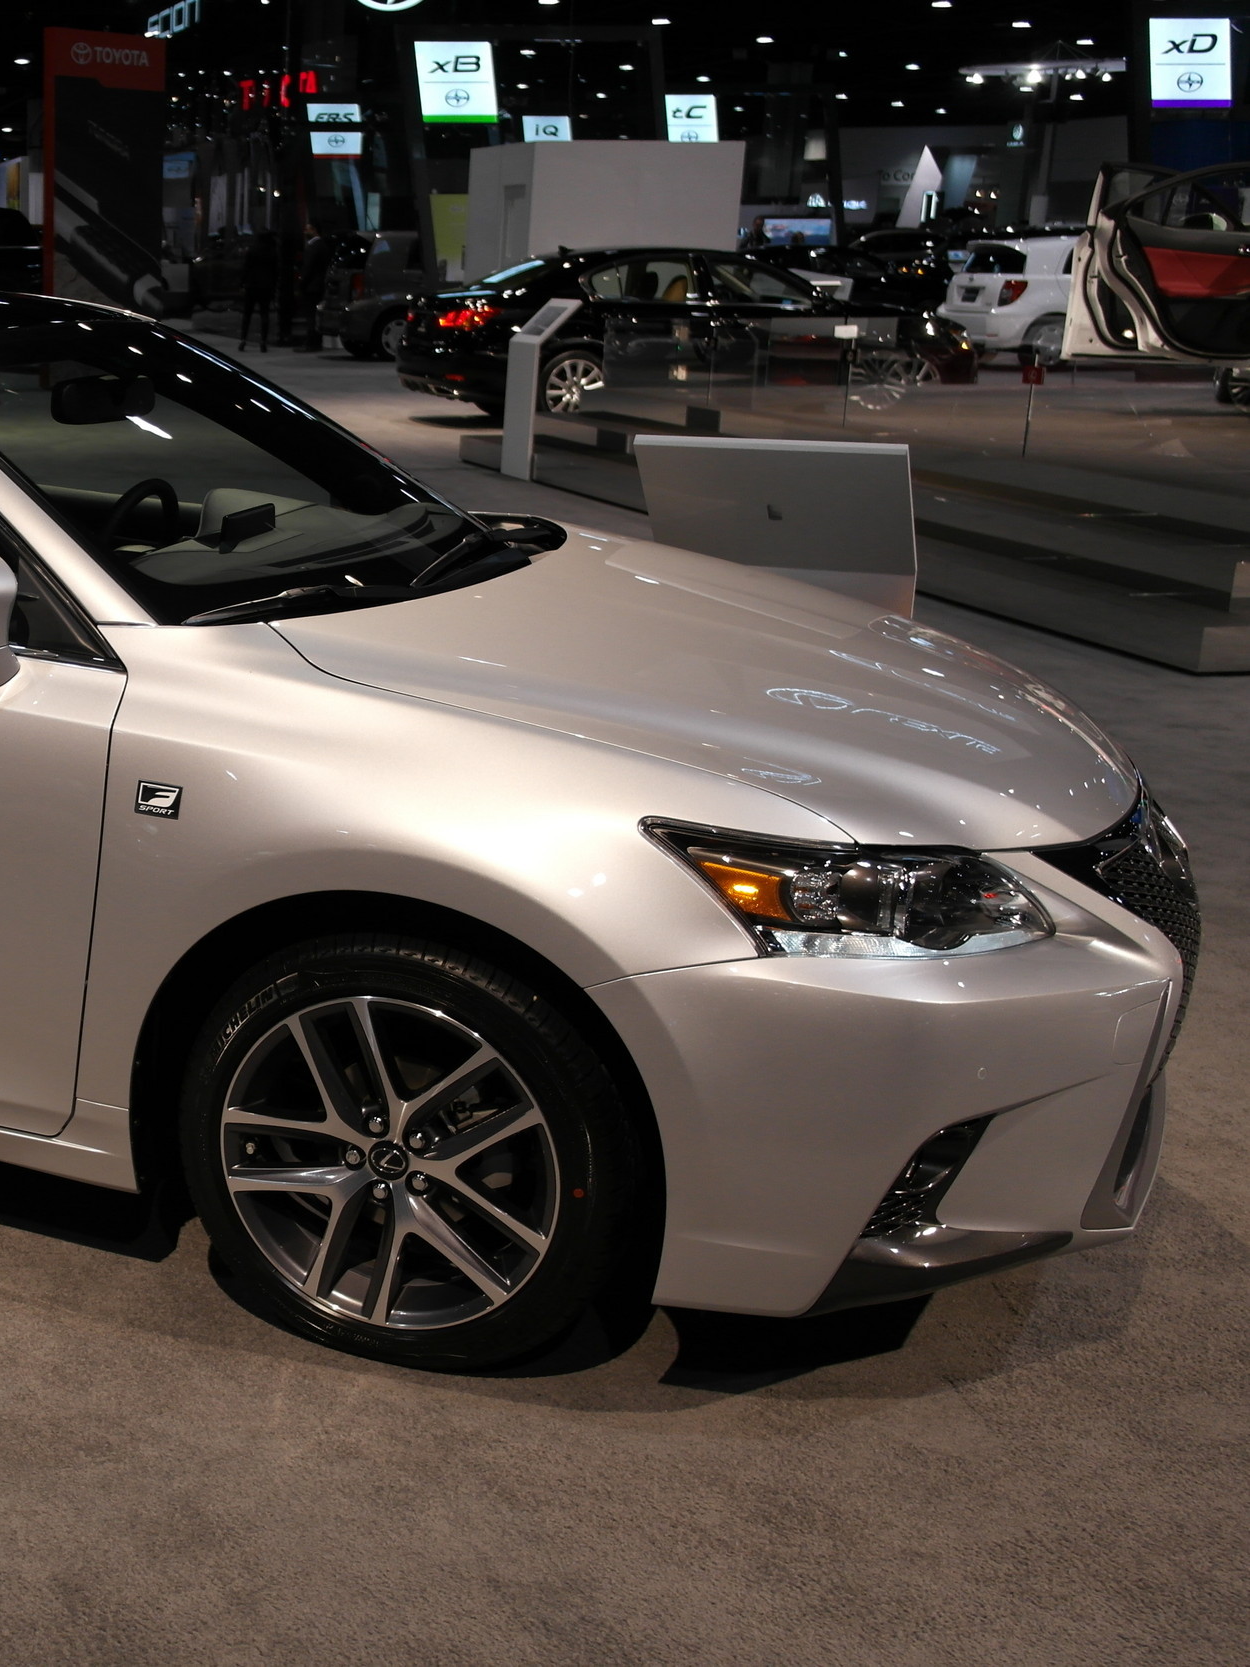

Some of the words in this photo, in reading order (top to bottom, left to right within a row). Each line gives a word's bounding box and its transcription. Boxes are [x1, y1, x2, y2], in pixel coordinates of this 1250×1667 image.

[1161, 33, 1218, 54] xD
[94, 47, 150, 66] TOYOTA
[428, 55, 481, 73] xB
[672, 105, 707, 119] tC
[138, 804, 175, 815] SPORT
